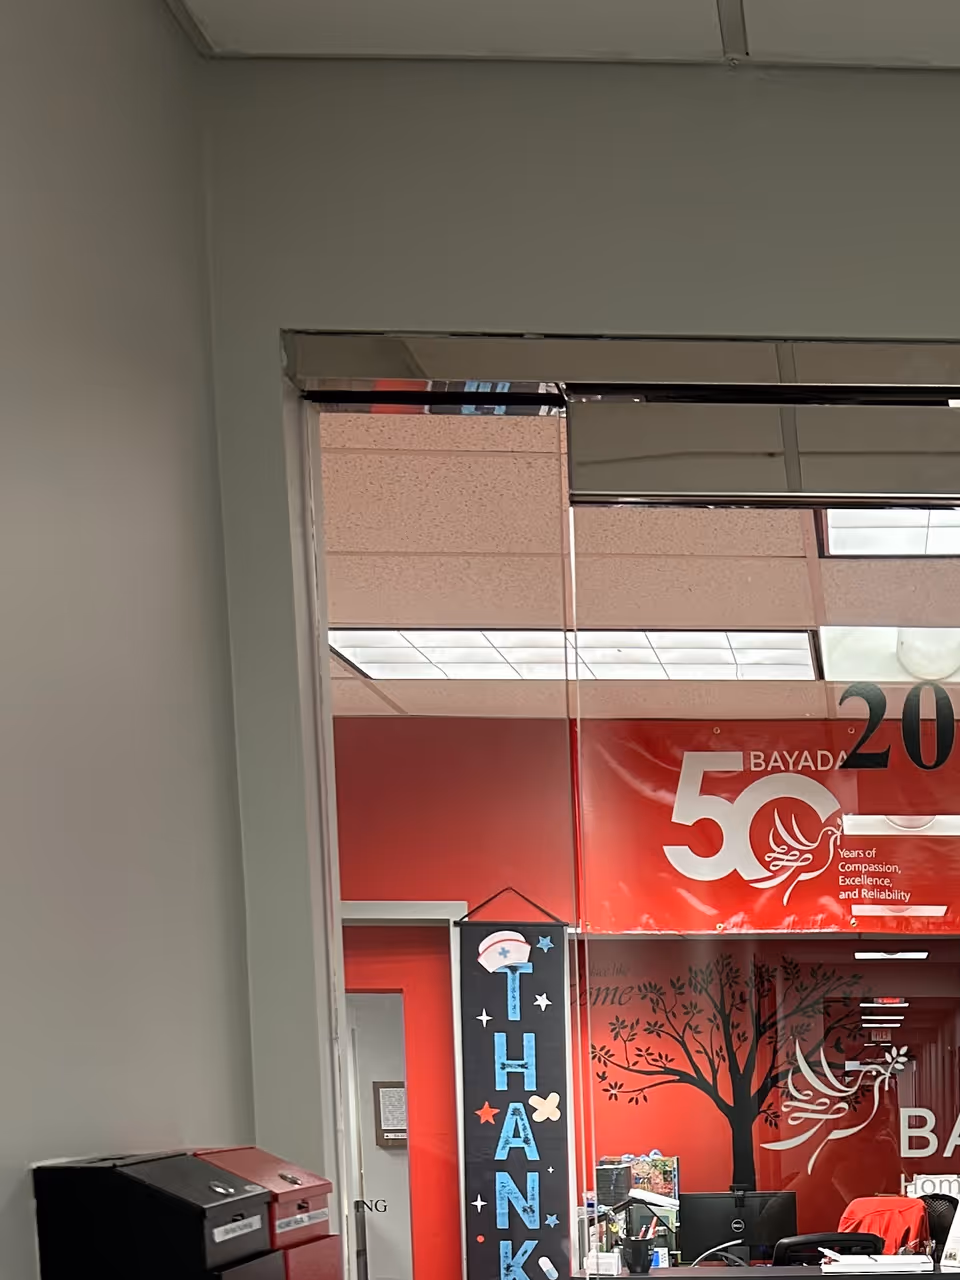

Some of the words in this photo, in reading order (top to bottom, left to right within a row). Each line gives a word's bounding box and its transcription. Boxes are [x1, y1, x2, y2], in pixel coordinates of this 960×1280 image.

[749, 751, 849, 772] BAYADA
[663, 751, 841, 886] 50
[838, 848, 864, 858] Years
[865, 847, 877, 858] of
[838, 861, 902, 875] Compassion,
[838, 874, 893, 887] Excellence,
[838, 888, 859, 899] and
[861, 888, 911, 903] Reliability
